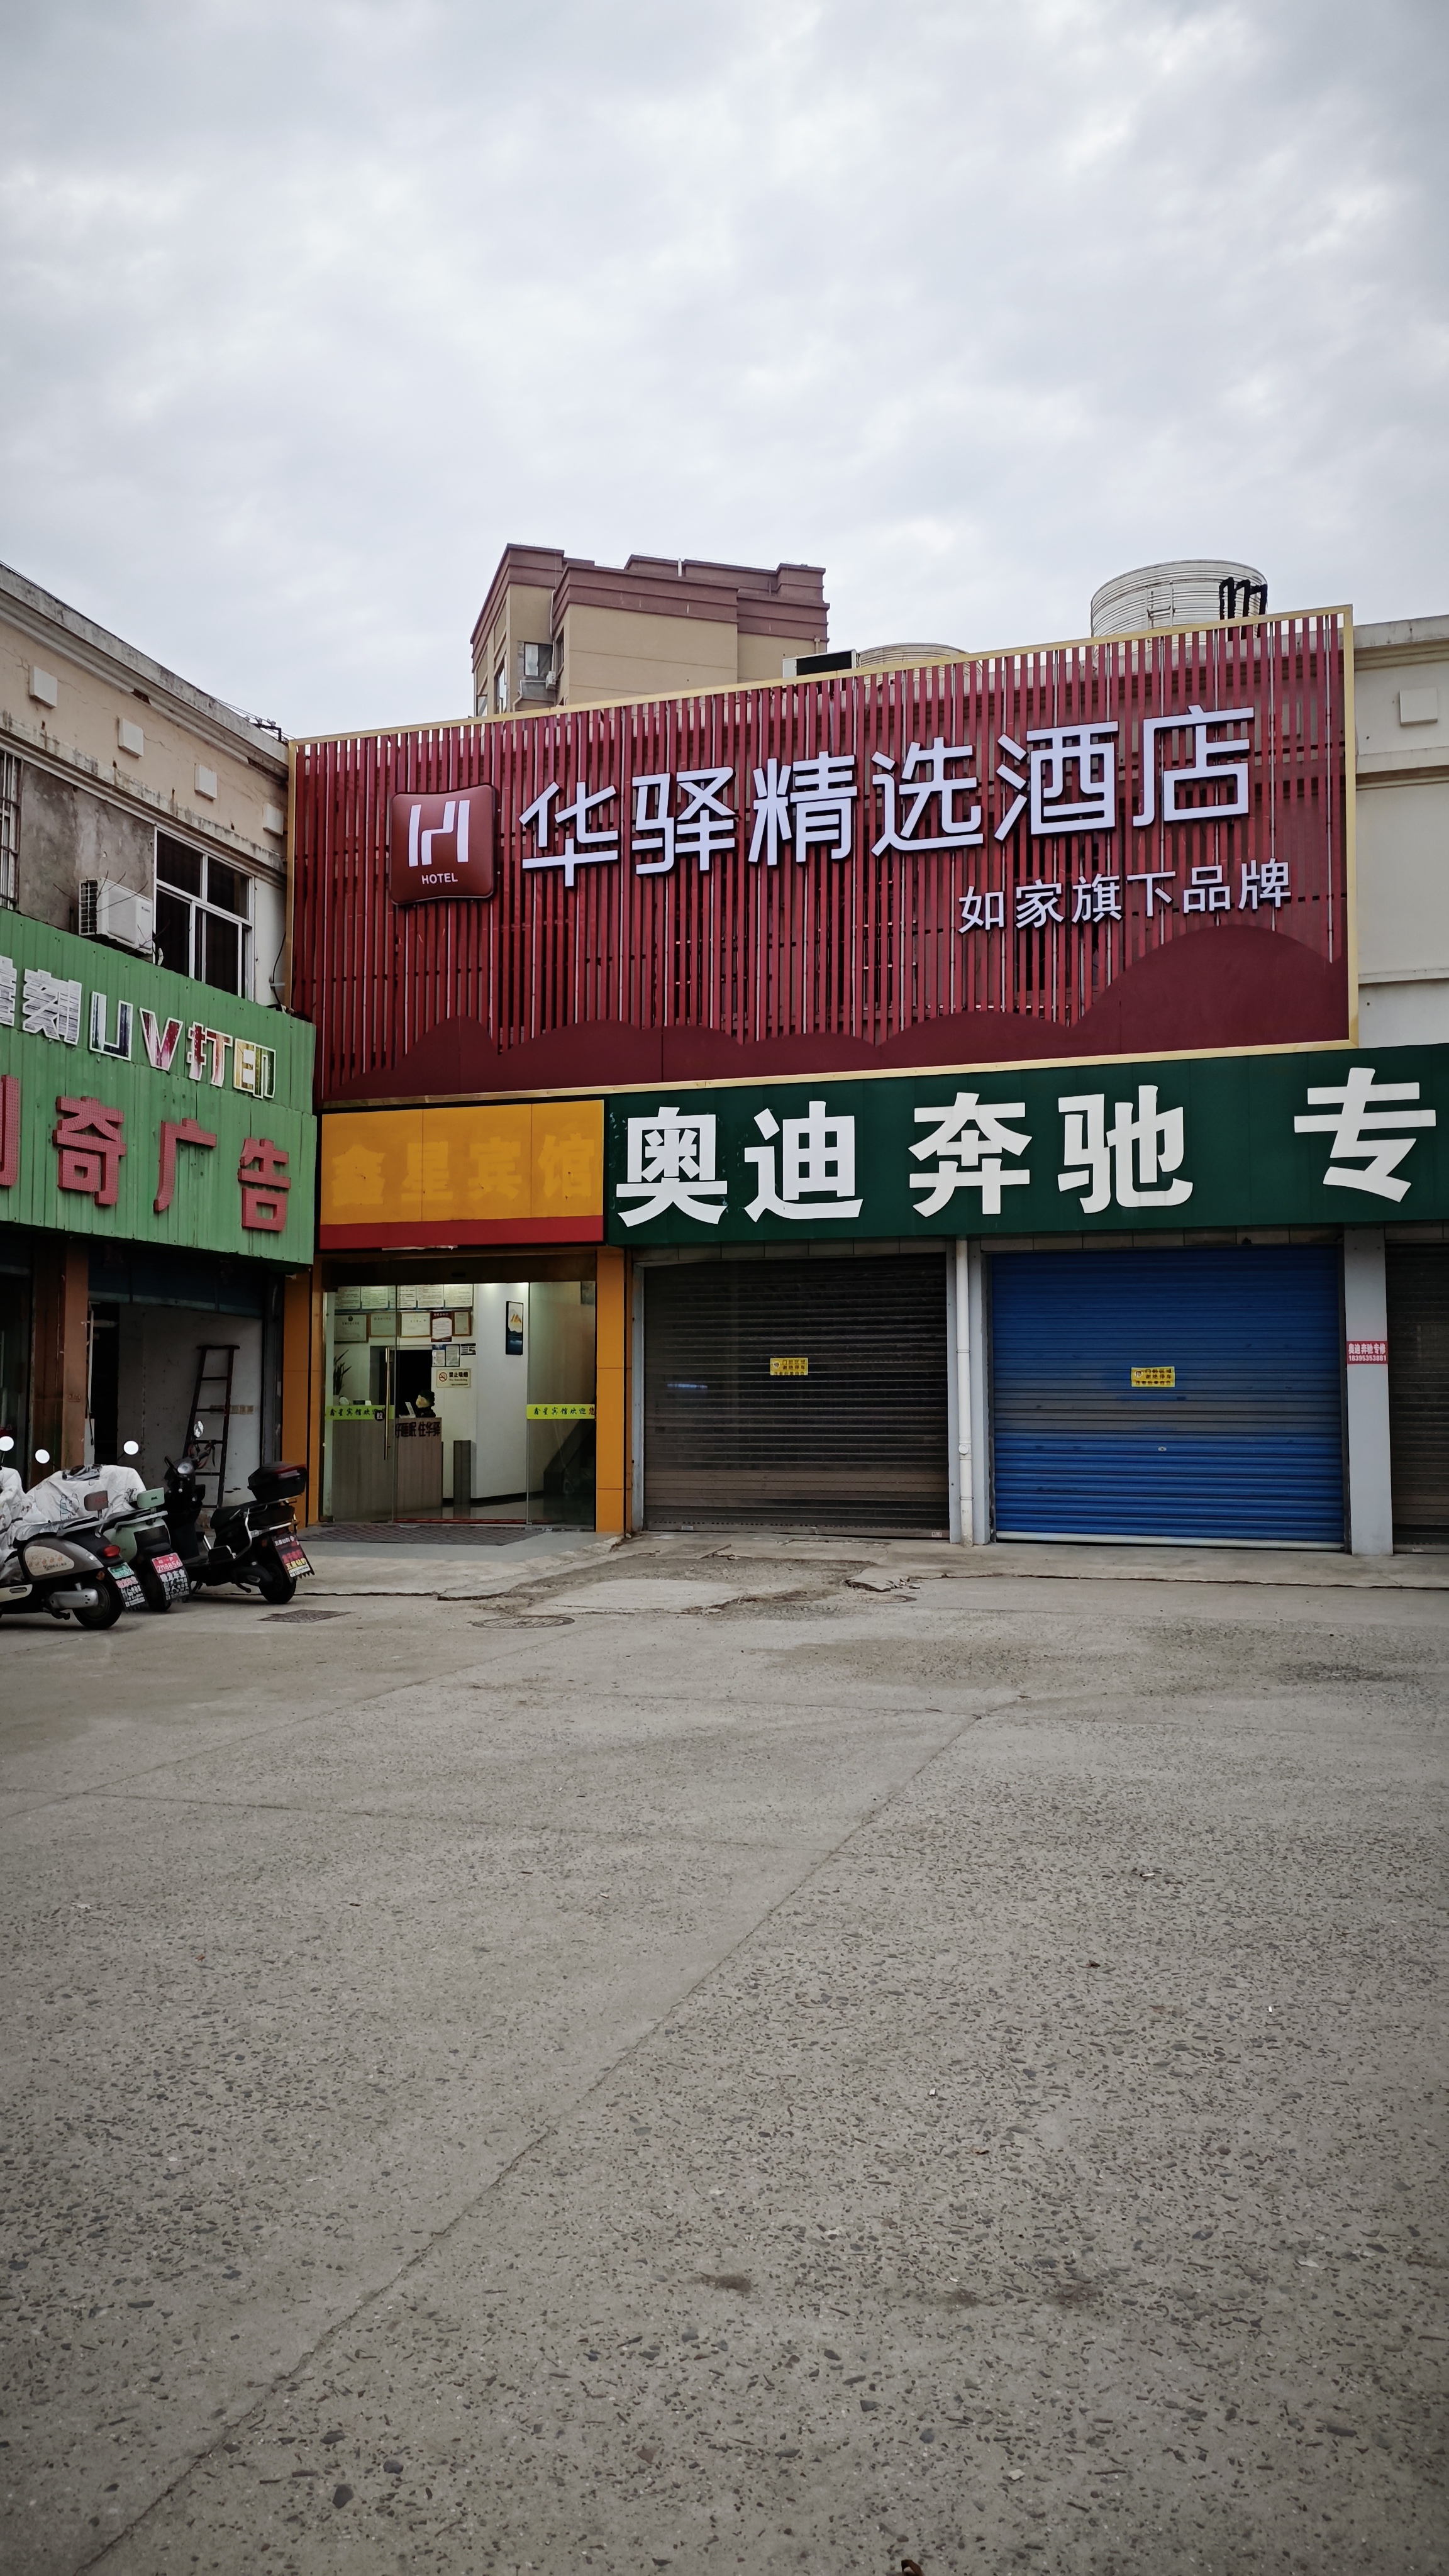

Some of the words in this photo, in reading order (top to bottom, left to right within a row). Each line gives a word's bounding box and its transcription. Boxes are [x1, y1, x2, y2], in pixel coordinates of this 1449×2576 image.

[518, 704, 1255, 887] 华驿精选酒店
[421, 872, 458, 886] HOTEL
[958, 857, 1292, 935] 如家旗下品牌
[0, 1074, 291, 1232] 奇广告
[1348, 1343, 1386, 1354] 奥迪奔驰专修
